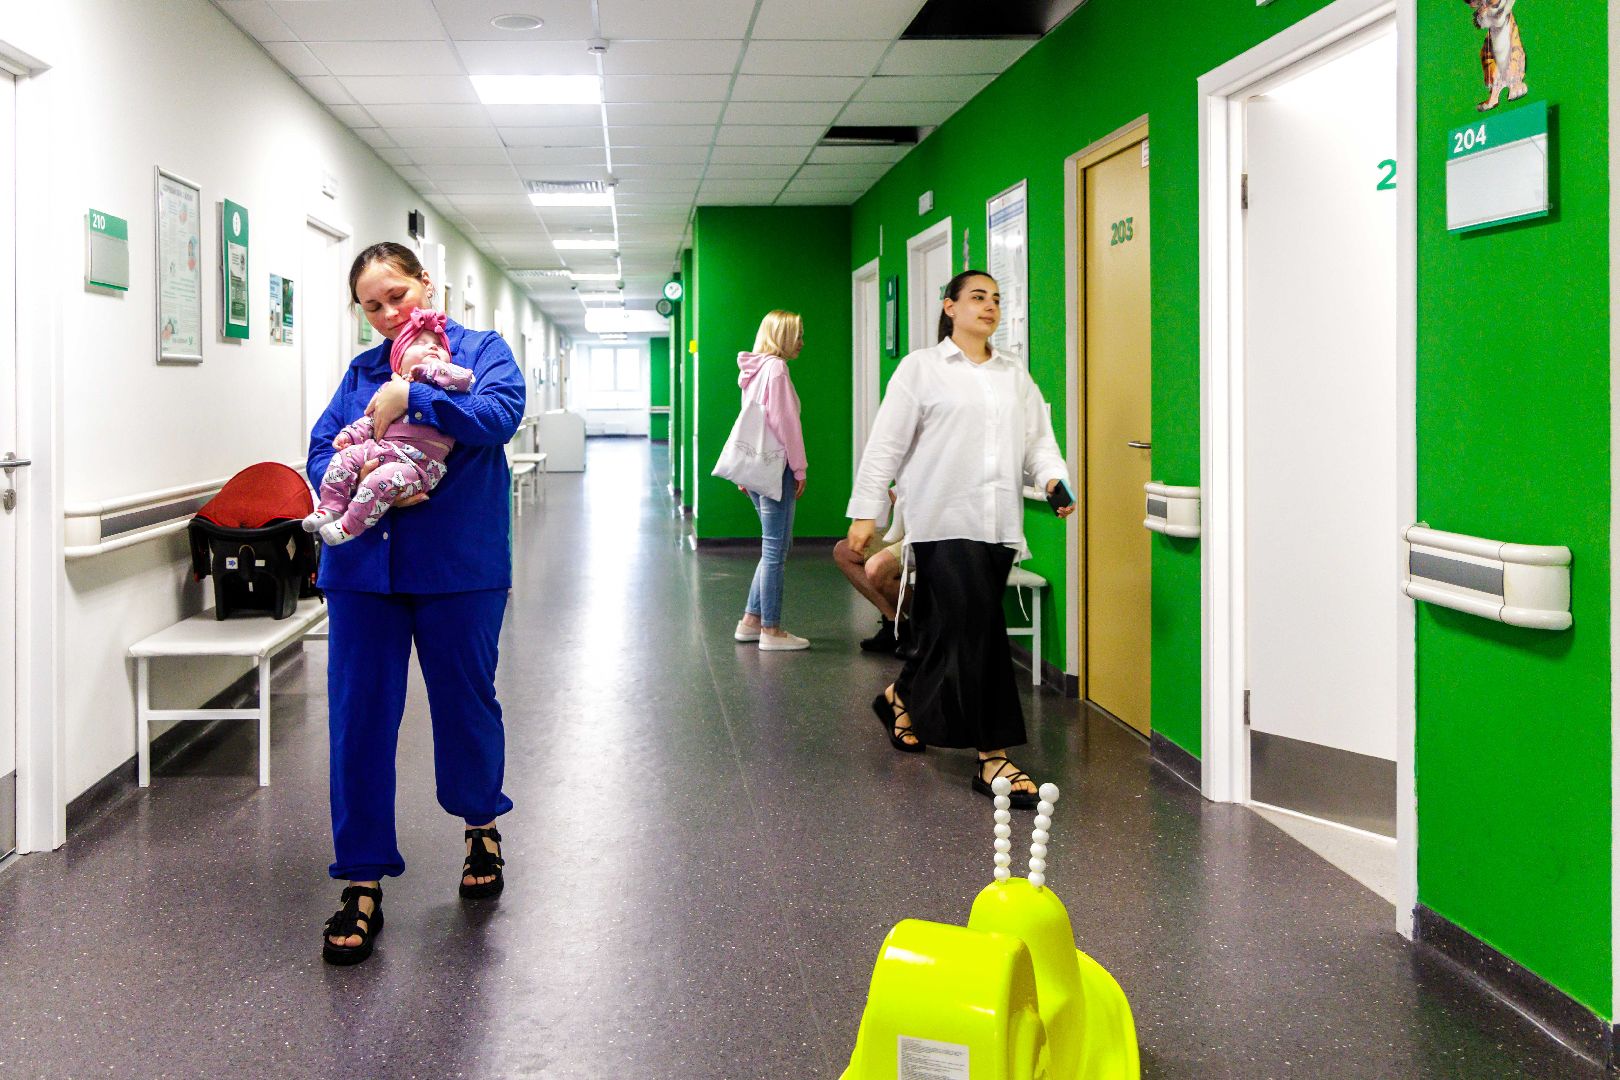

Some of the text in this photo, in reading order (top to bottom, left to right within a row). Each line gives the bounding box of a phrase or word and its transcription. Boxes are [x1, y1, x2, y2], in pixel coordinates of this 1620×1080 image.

[1453, 124, 1487, 153] 204
[92, 213, 106, 230] 210
[1110, 217, 1133, 246] 203
